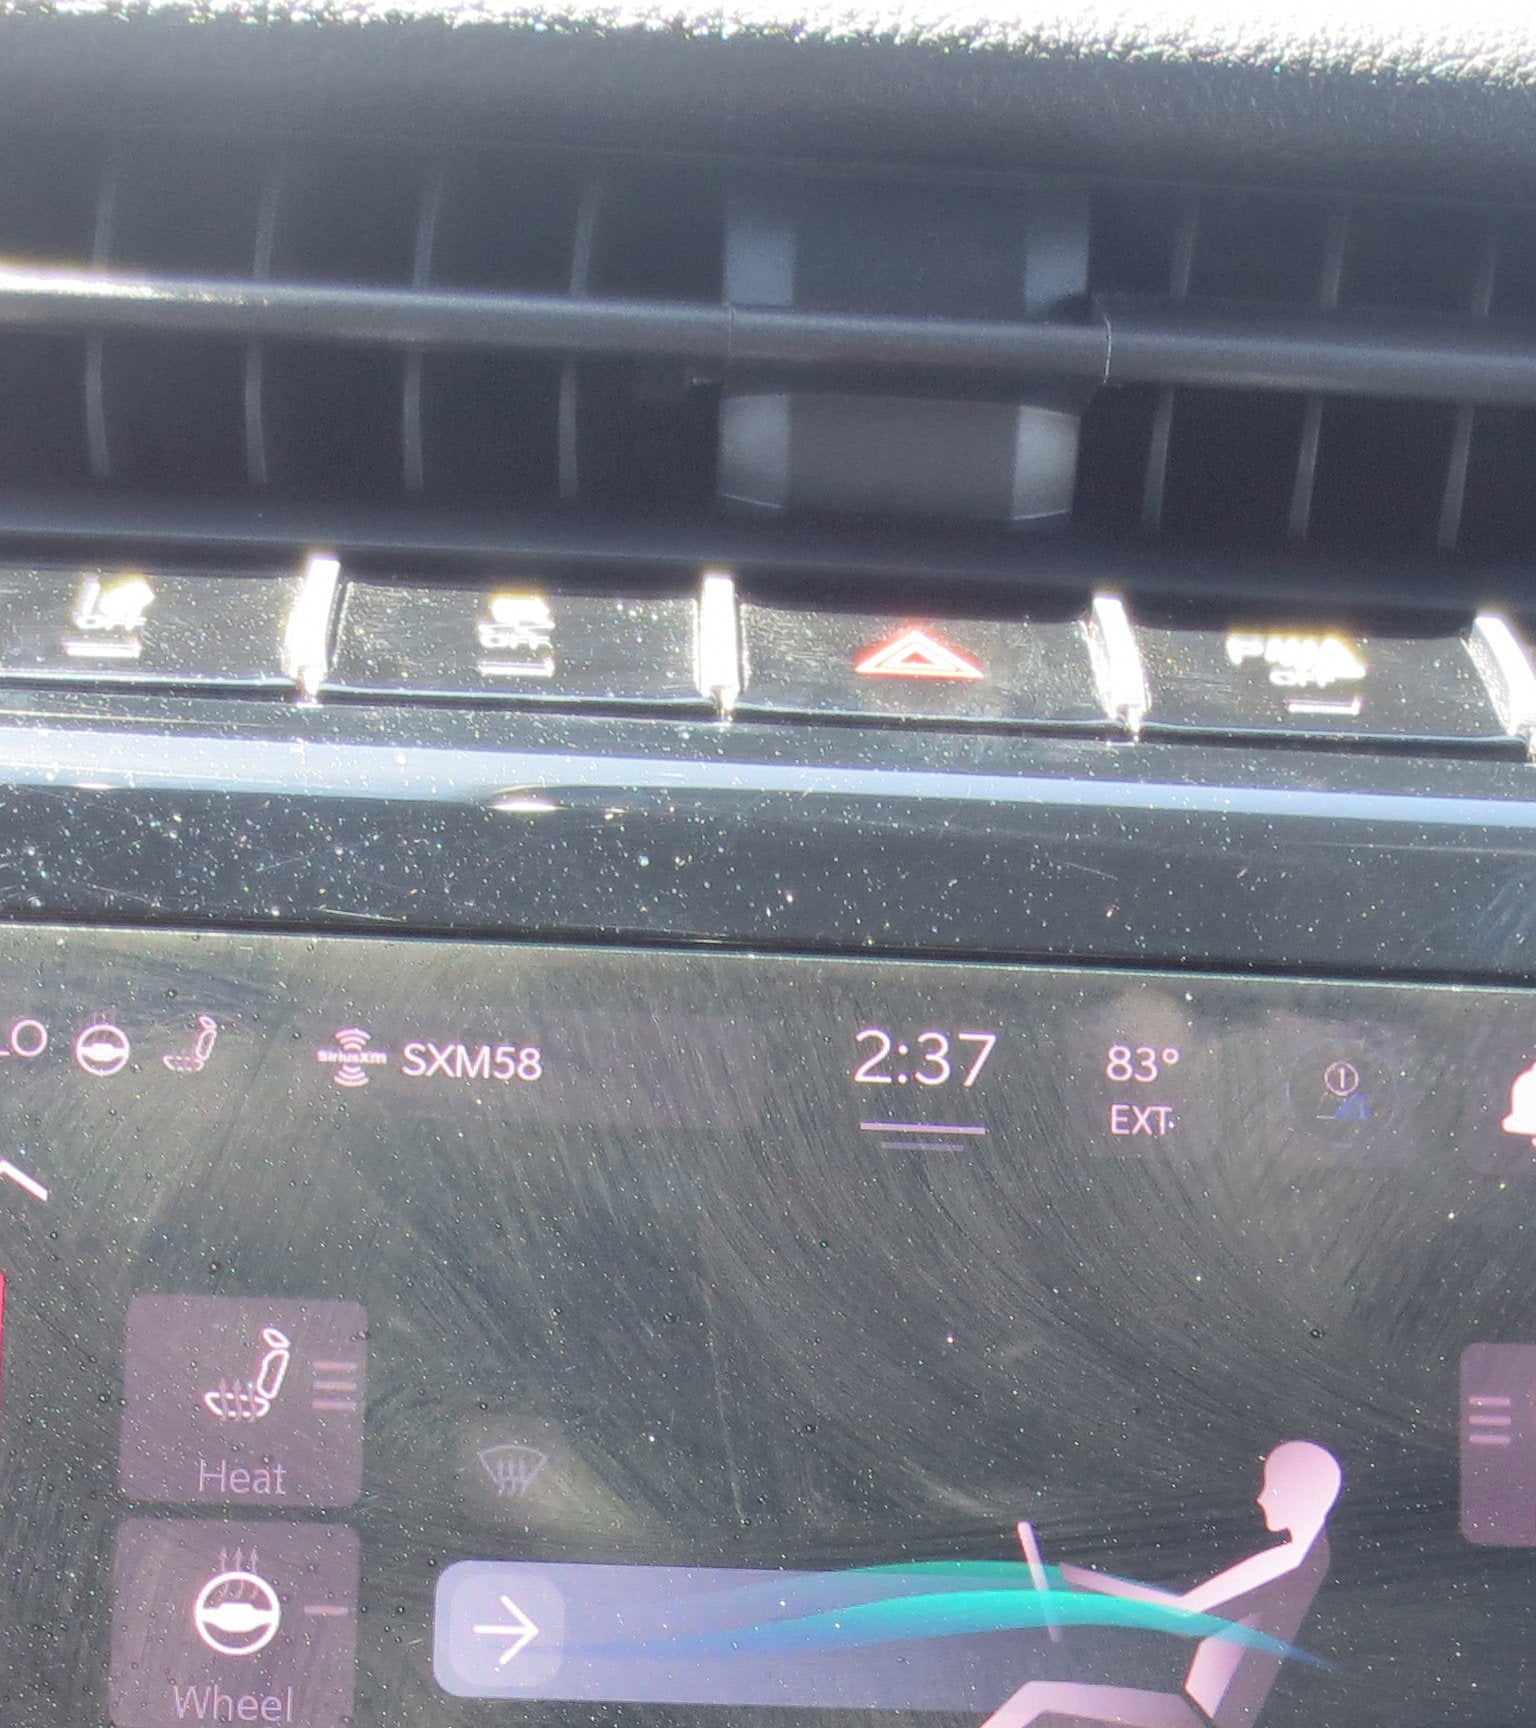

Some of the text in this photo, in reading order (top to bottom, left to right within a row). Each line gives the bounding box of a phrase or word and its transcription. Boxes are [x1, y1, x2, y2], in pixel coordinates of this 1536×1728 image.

[402, 1042, 542, 1081] SXM58
[854, 1028, 997, 1086] 2:37
[1106, 1044, 1179, 1083] 83°
[1111, 1103, 1171, 1137] EXT
[198, 1457, 287, 1496] Heat
[173, 1684, 293, 1722] Wheel
